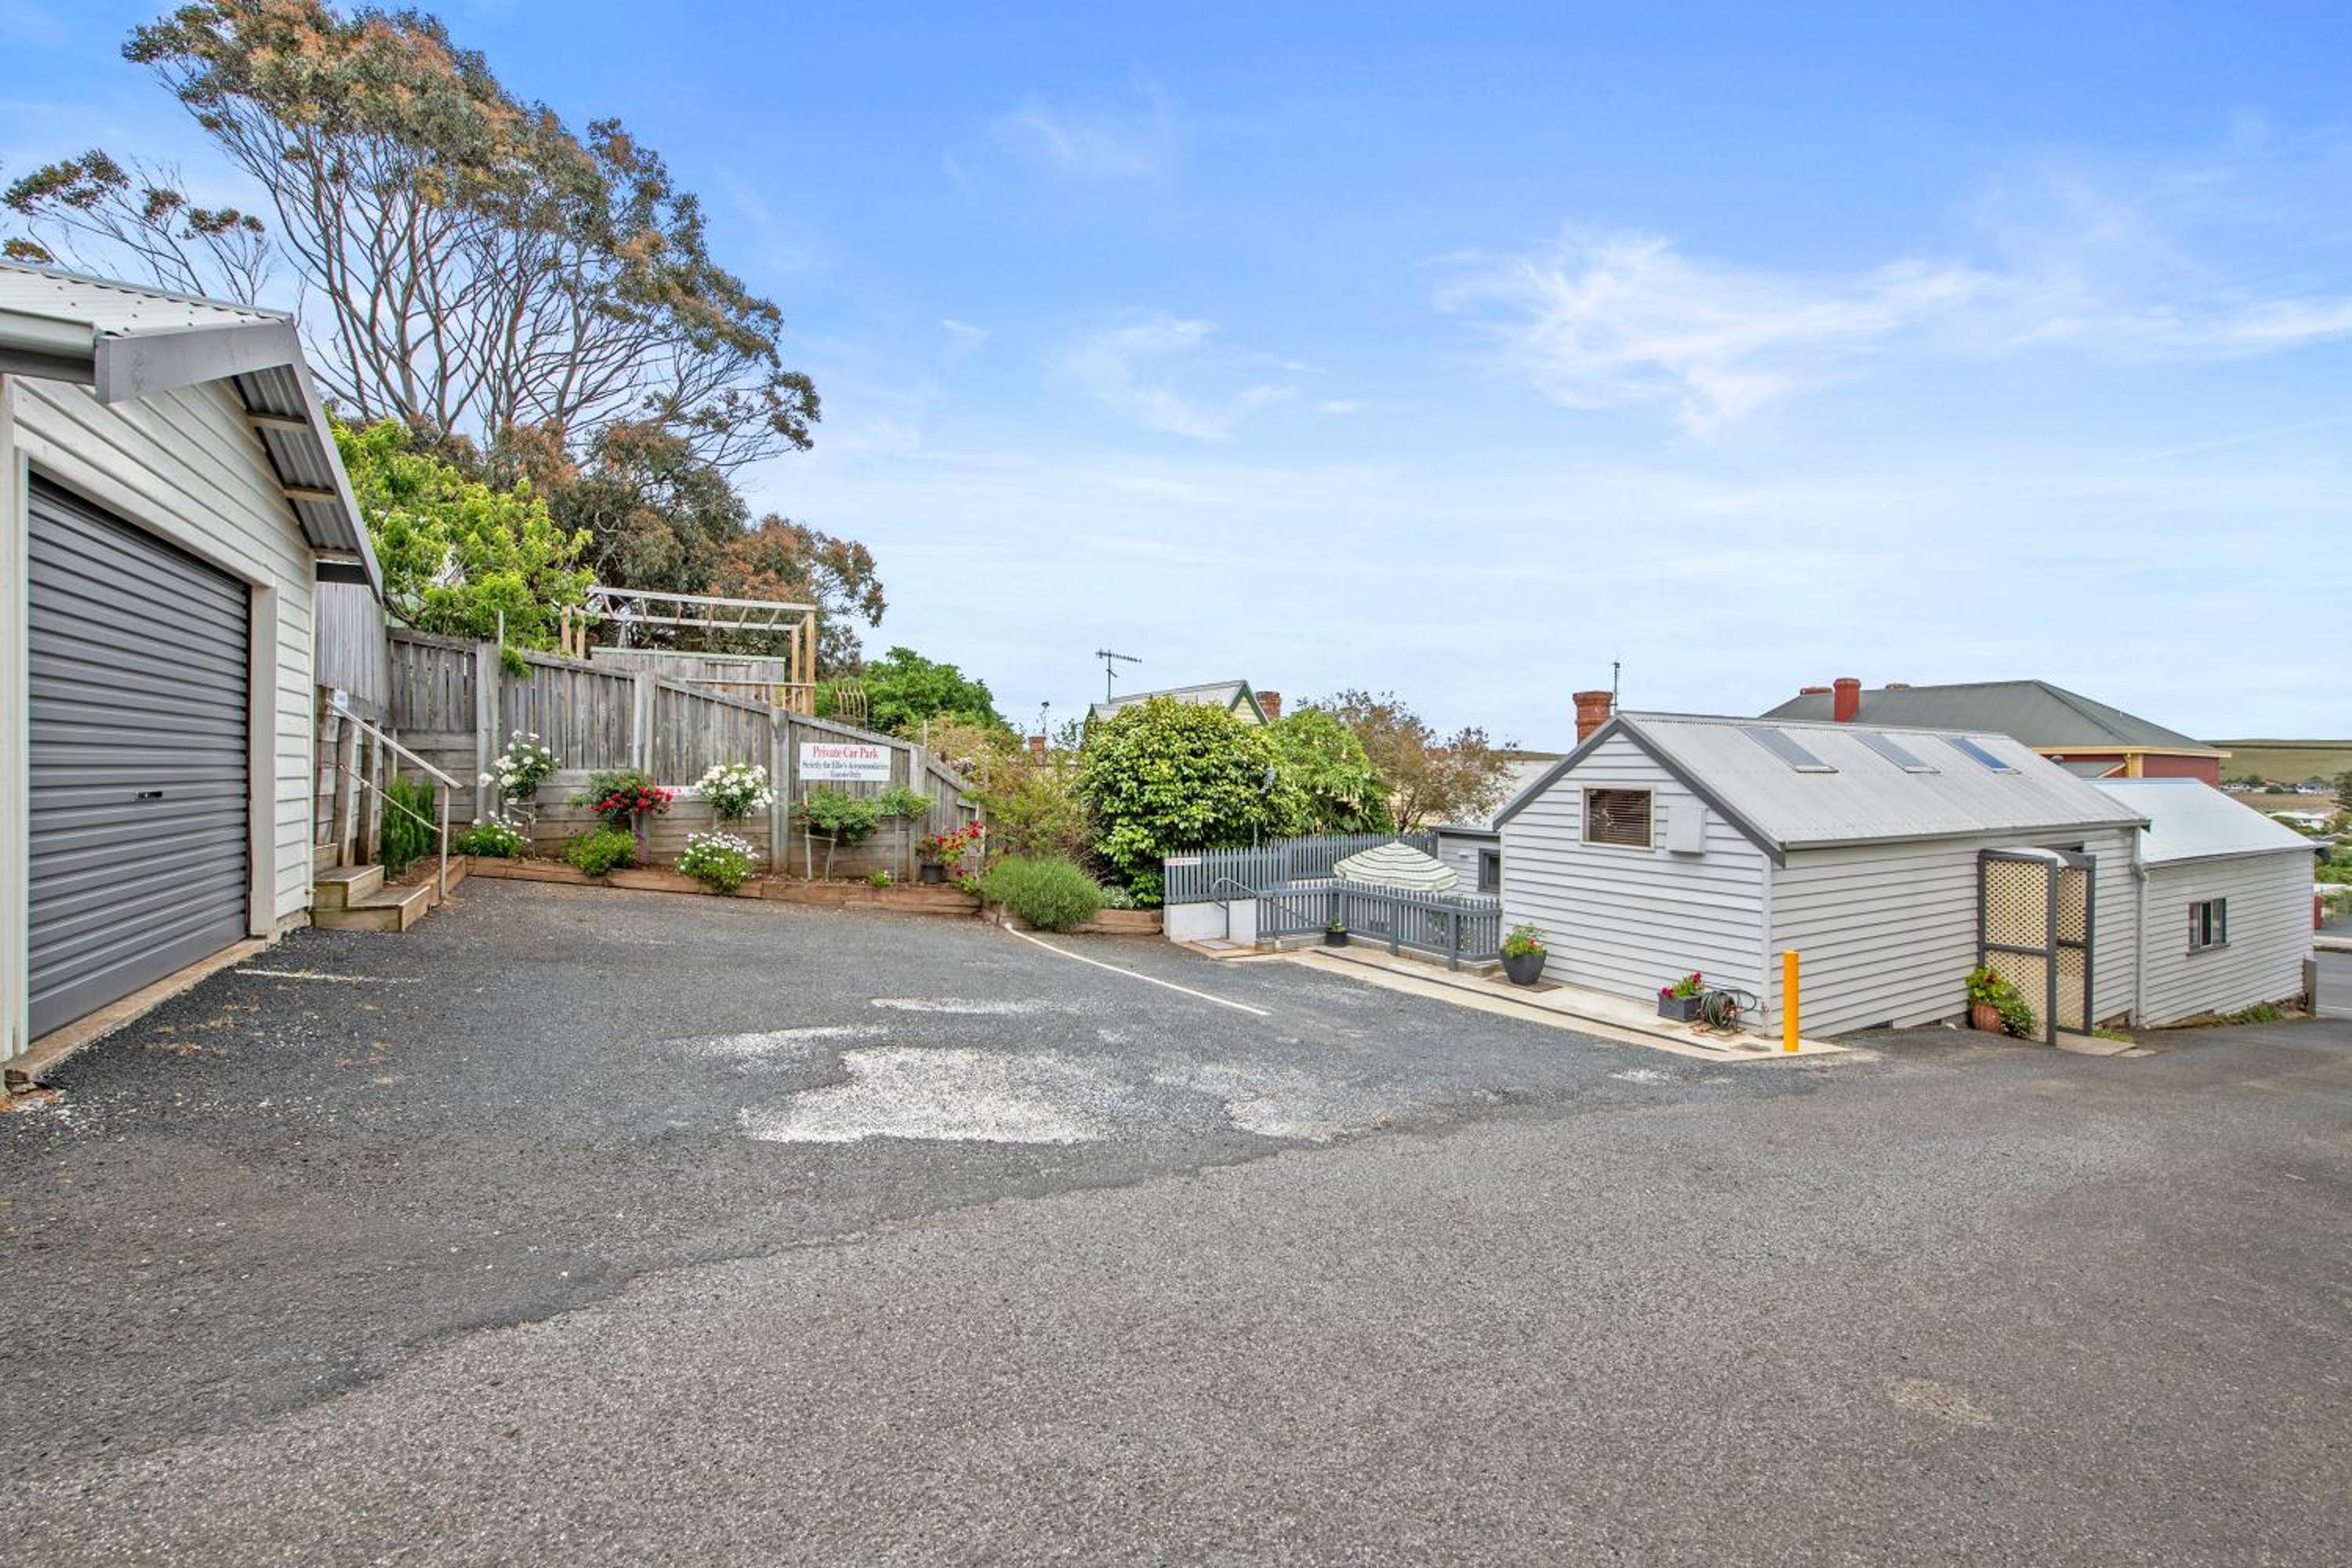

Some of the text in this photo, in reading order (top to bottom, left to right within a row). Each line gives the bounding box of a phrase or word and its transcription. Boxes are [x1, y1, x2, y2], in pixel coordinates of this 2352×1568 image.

[813, 746, 879, 759] Private Car Park
